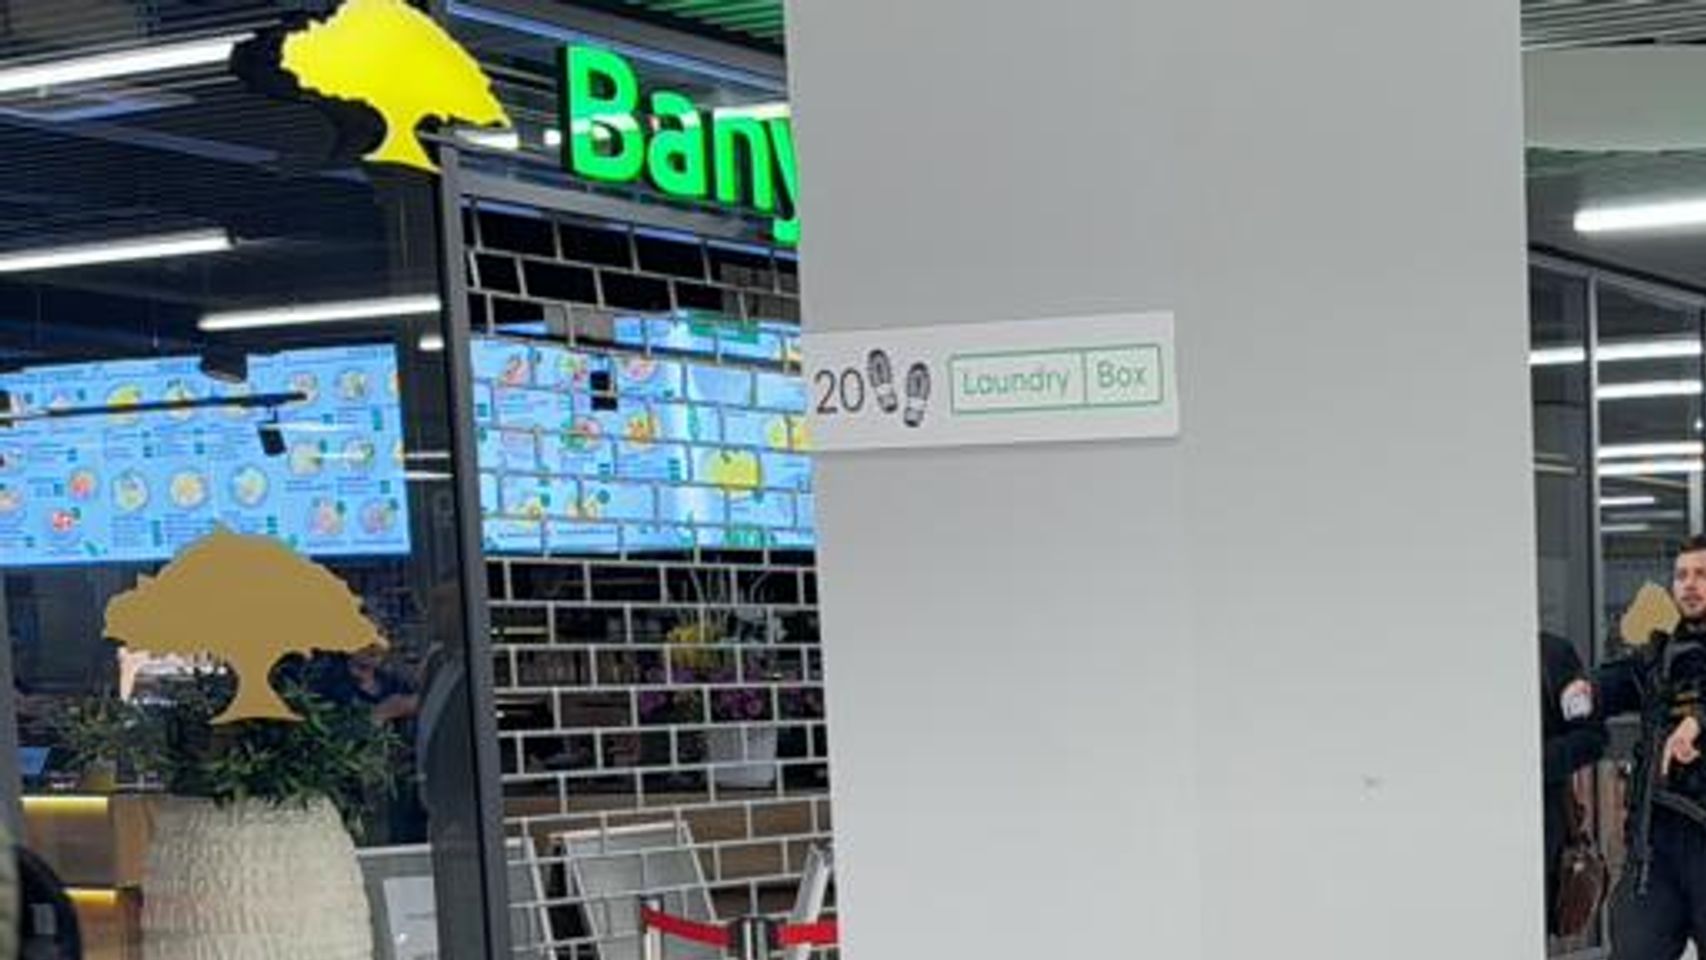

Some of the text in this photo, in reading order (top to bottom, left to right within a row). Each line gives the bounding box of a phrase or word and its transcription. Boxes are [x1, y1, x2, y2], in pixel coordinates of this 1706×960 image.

[815, 360, 1148, 414] 20 Laundry Box
